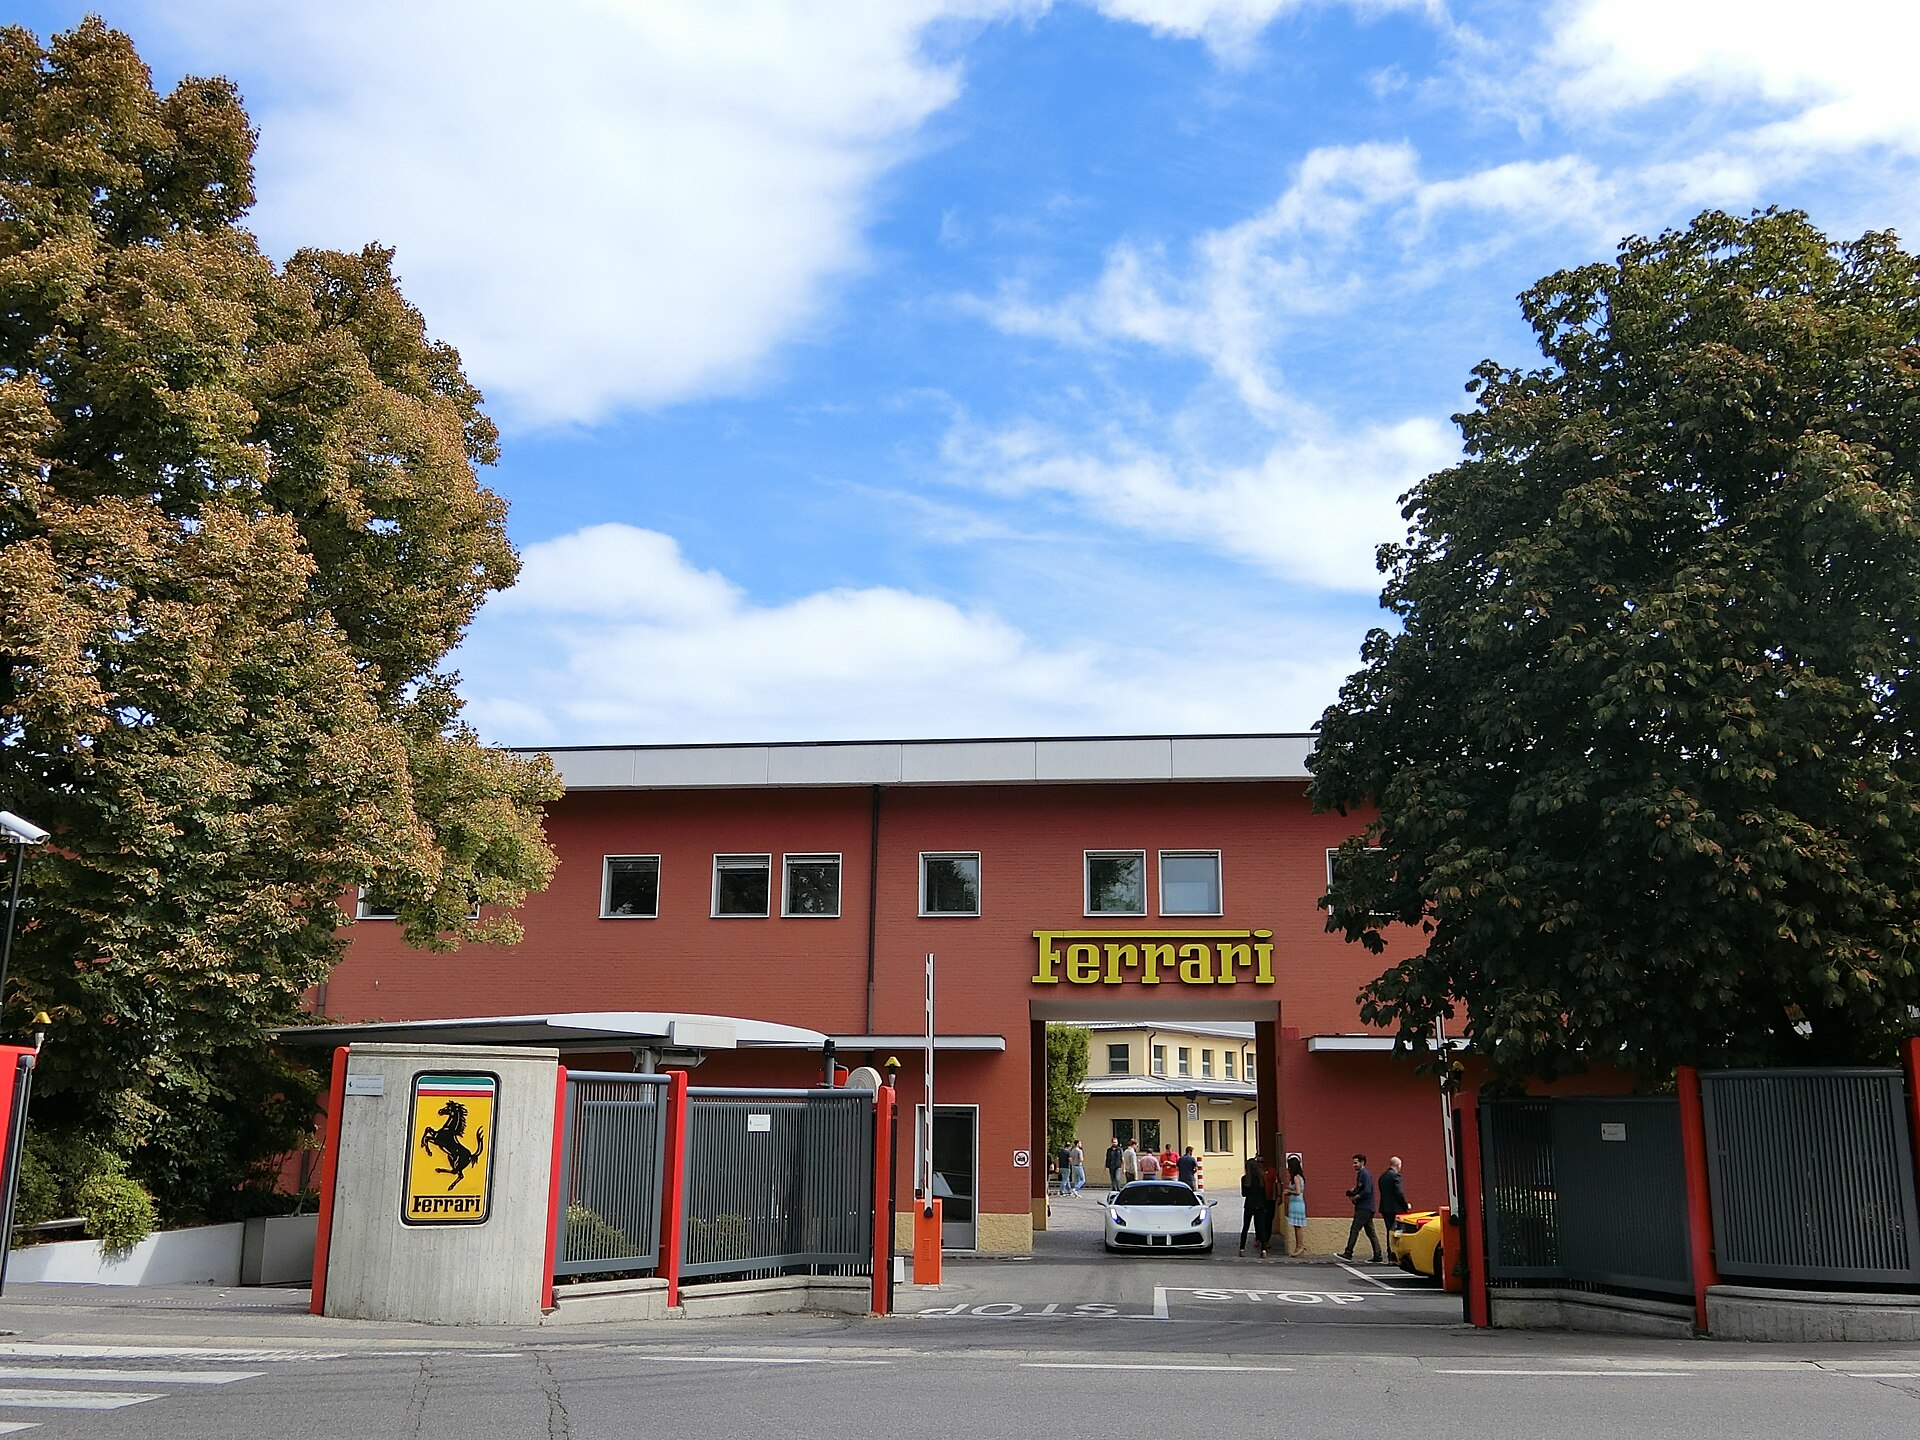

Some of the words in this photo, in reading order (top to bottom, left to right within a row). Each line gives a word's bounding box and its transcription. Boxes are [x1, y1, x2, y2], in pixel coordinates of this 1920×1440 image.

[1032, 929, 1276, 984] Ferrari
[412, 1195, 481, 1212] Ferrari
[1192, 1290, 1365, 1305] STOP
[917, 1303, 1118, 1317] STOP
